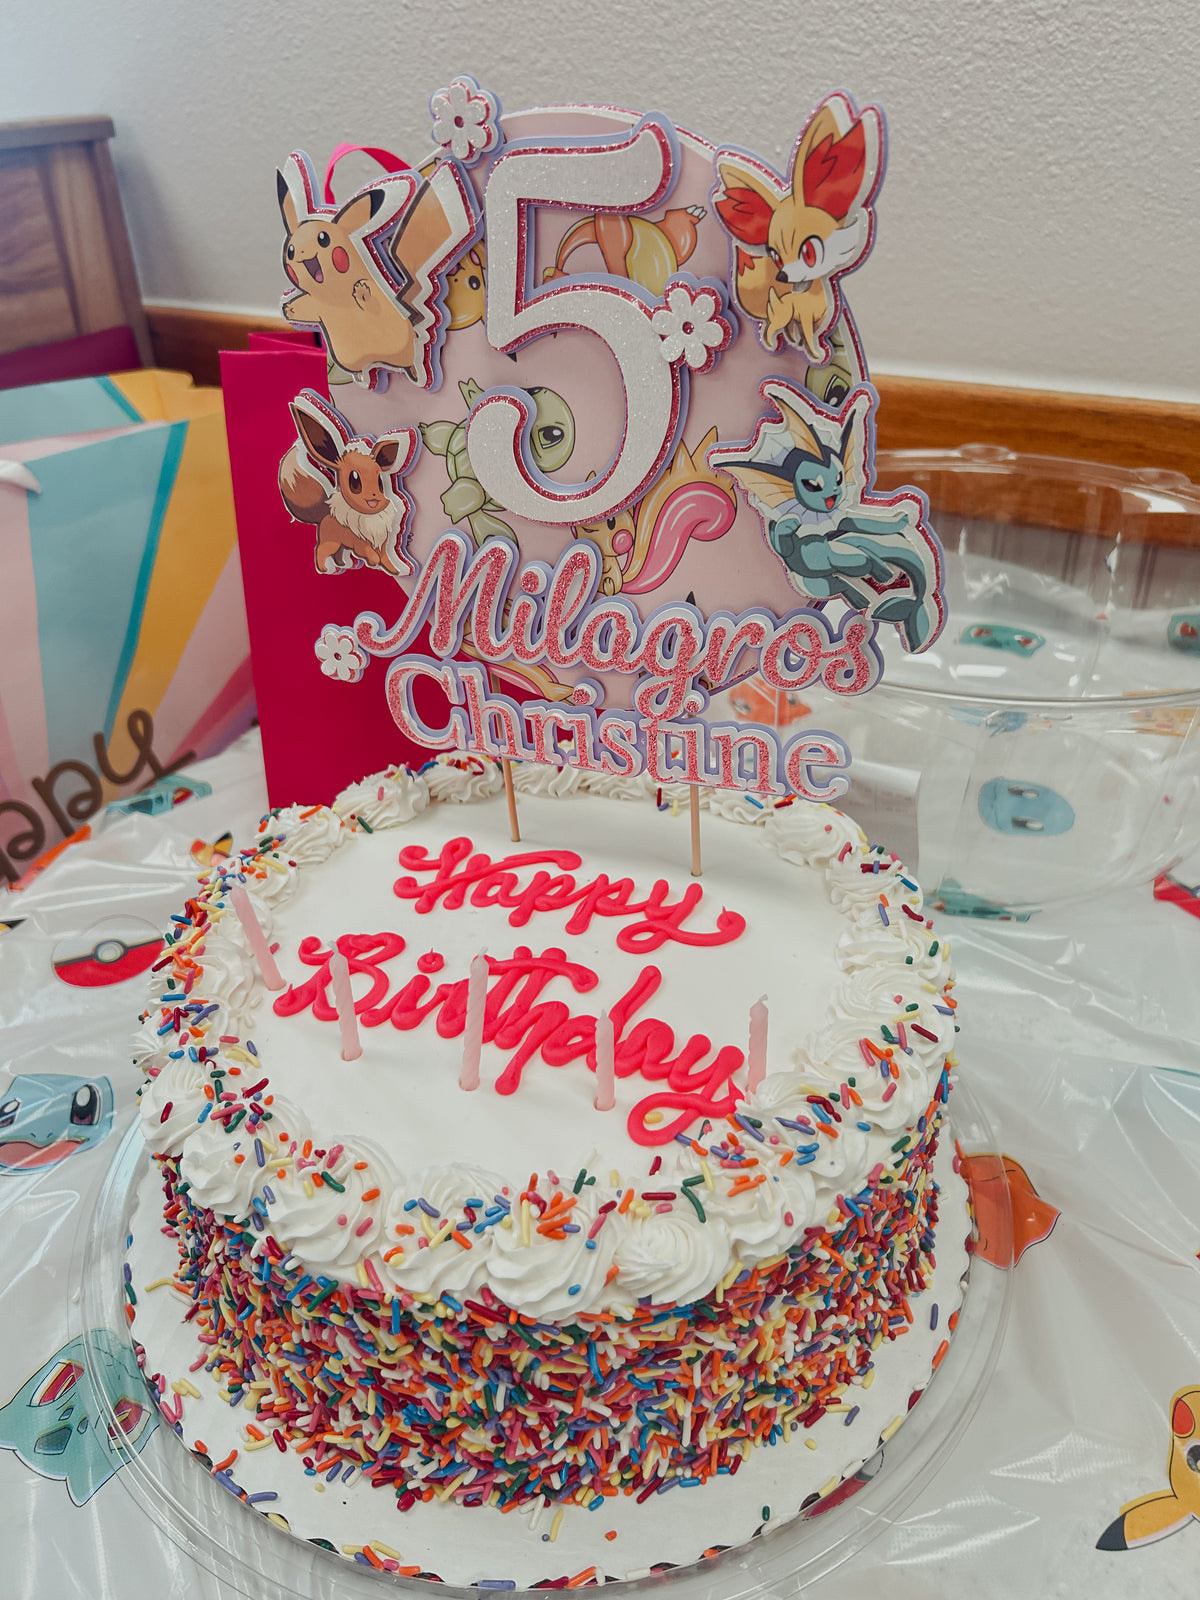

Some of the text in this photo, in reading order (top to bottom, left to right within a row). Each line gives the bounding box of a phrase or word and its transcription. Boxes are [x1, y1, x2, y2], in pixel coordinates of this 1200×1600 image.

[356, 537, 874, 719] Milagros
[389, 662, 848, 799] Christine
[393, 836, 746, 954] Happy
[272, 931, 745, 1147] Birthday
